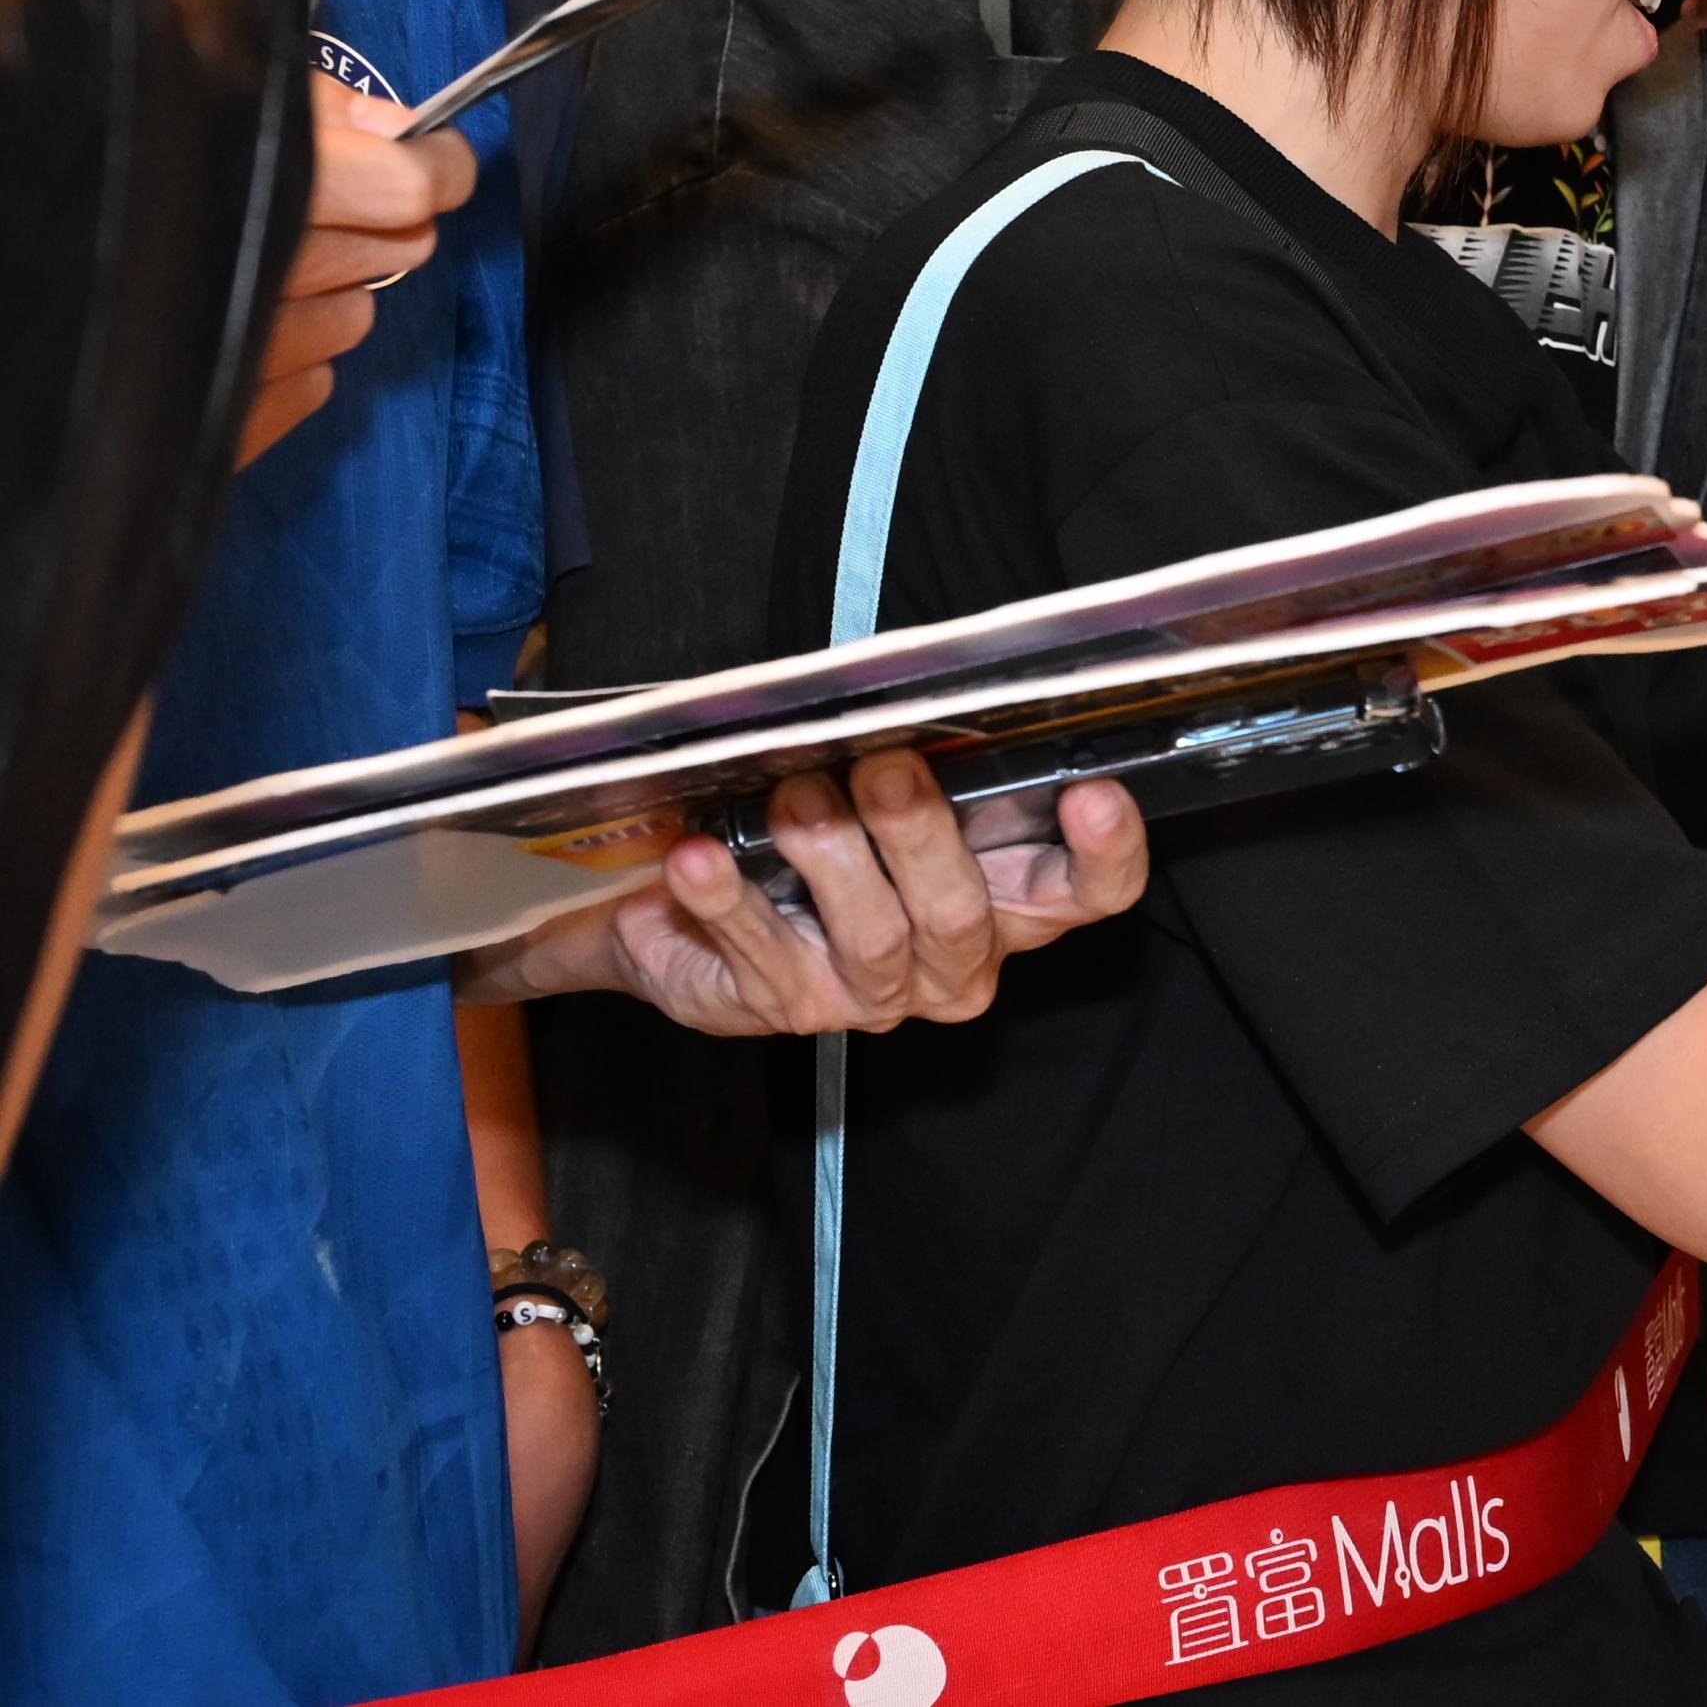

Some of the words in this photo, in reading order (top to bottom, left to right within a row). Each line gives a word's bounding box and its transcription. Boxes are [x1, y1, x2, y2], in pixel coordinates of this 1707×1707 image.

[308, 44, 371, 97] SEA
[1158, 1526, 1326, 1667] 置富
[1331, 1474, 1510, 1617] Malls
